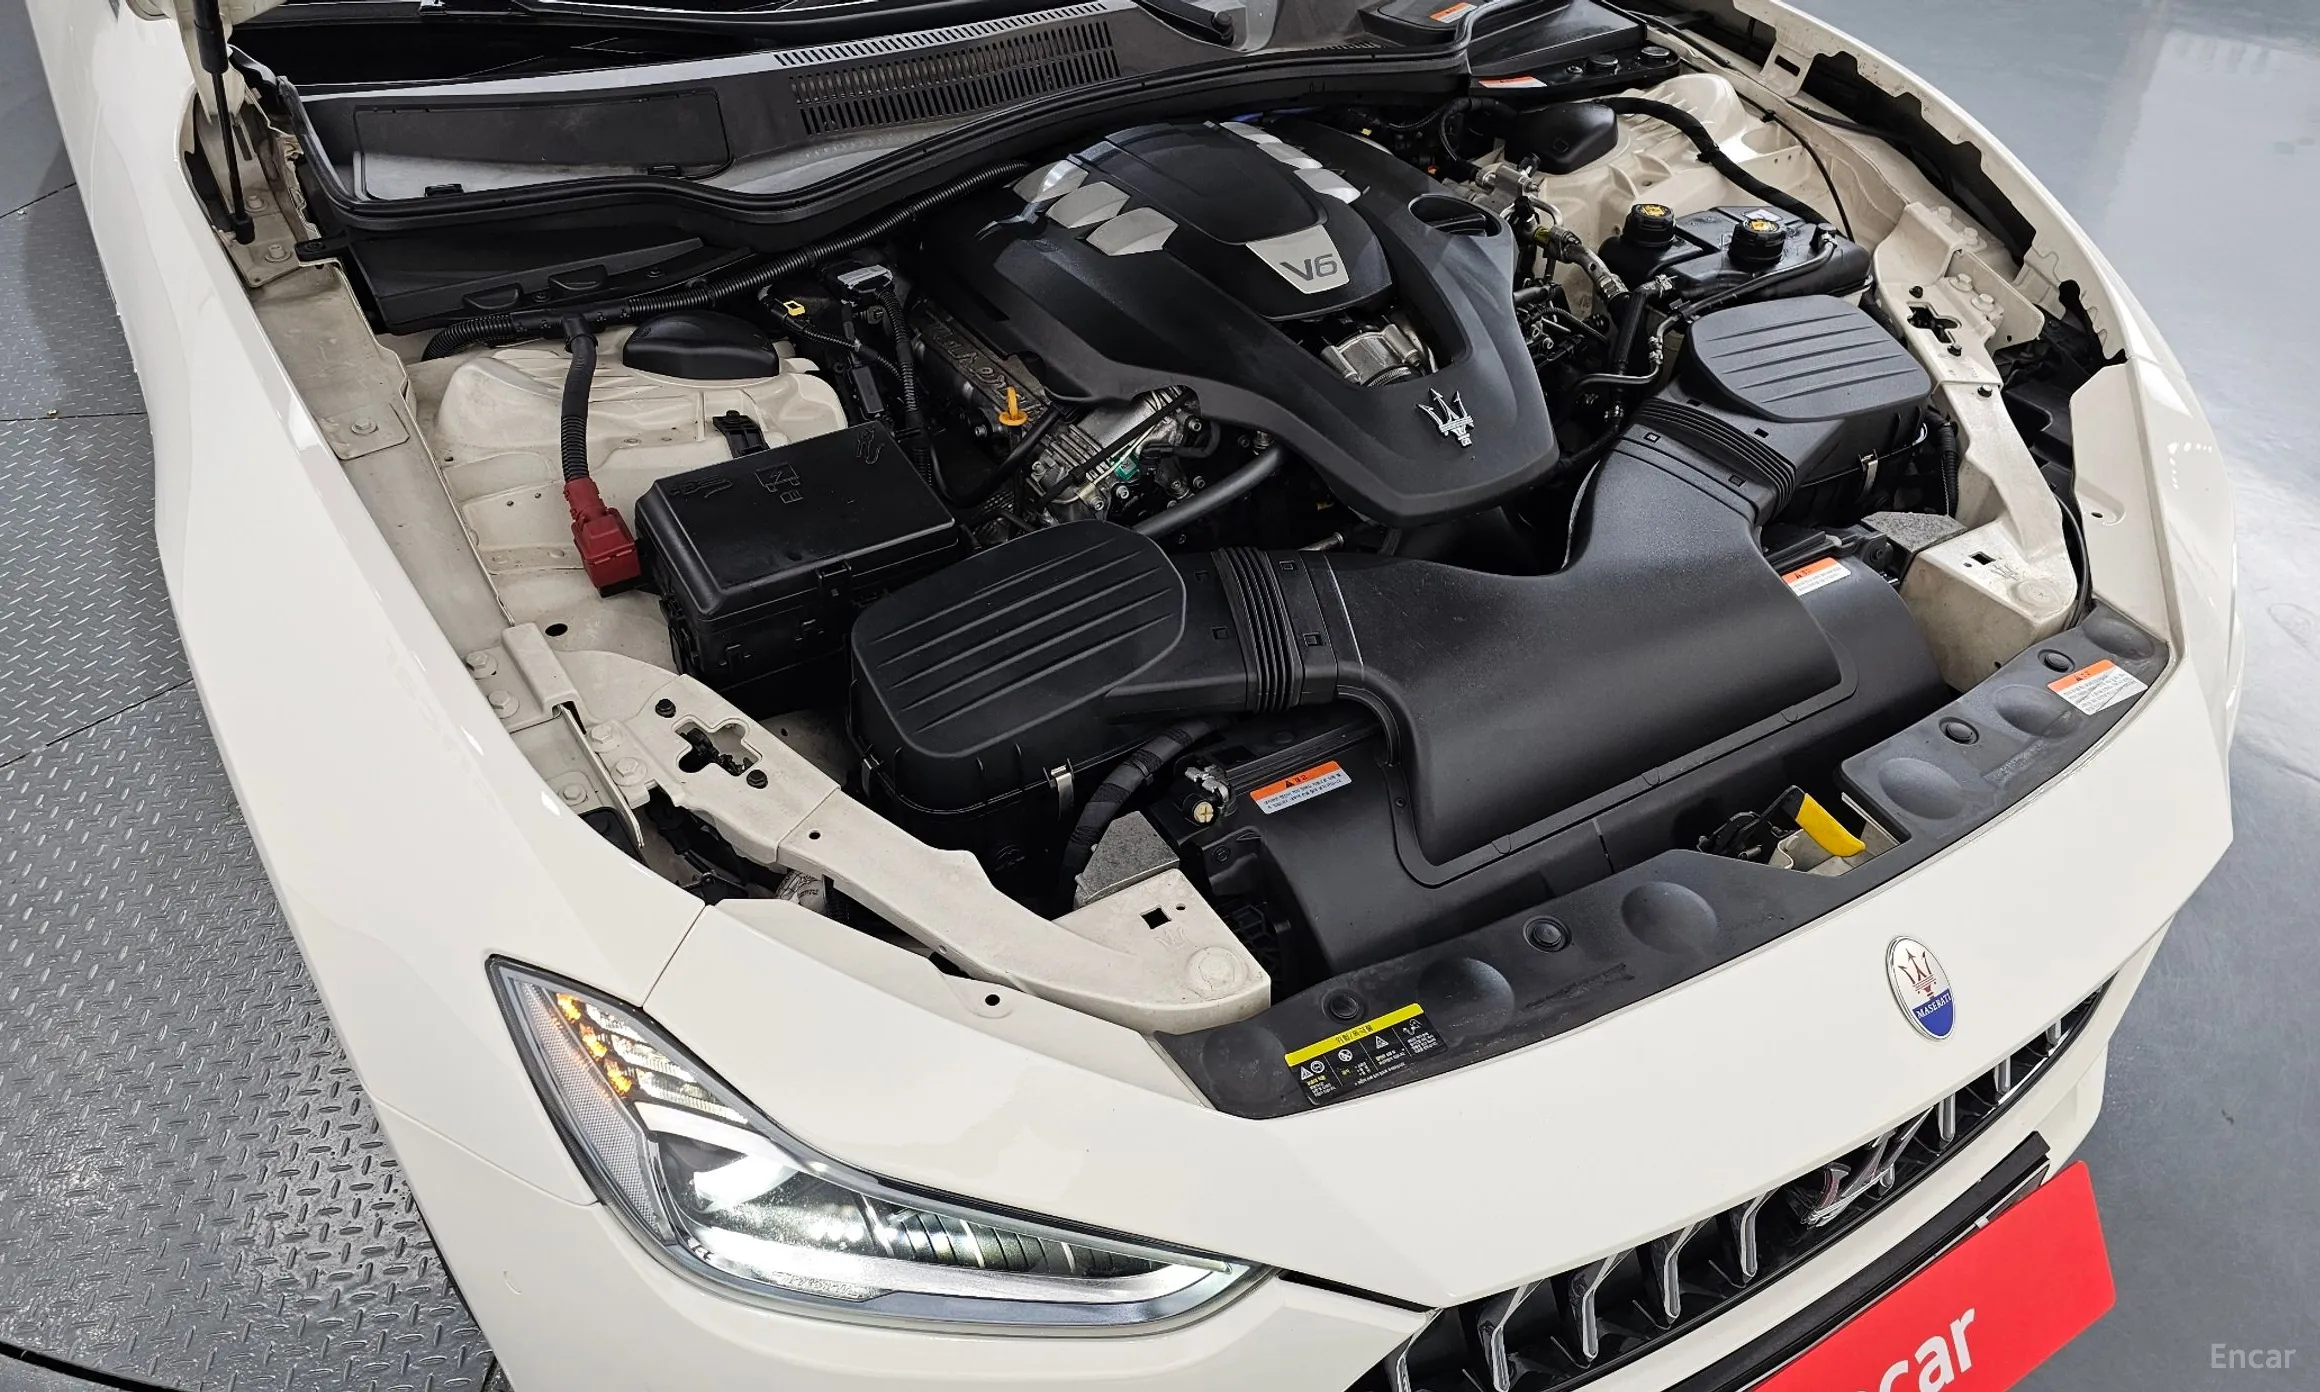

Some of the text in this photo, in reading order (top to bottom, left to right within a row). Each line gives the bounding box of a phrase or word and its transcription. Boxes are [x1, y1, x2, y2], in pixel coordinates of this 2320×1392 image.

[1279, 253, 1338, 282] V6
[1915, 992, 1953, 1019] MASERATI
[1856, 1308, 1976, 1392] car
